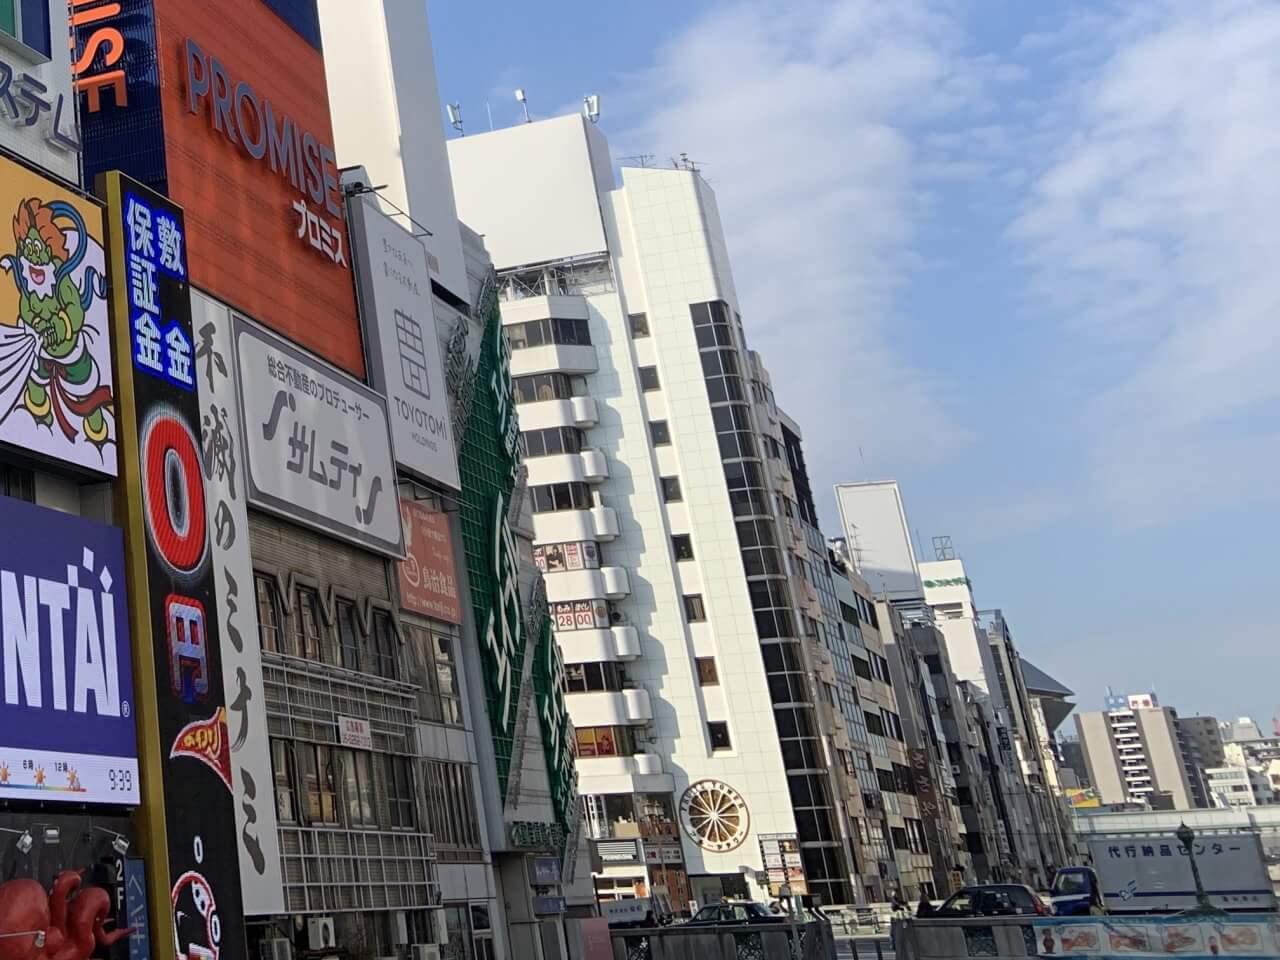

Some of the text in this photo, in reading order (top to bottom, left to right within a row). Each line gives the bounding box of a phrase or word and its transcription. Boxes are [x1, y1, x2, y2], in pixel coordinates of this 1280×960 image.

[184, 36, 342, 220] PROMISE
[292, 199, 349, 270] プロミス
[126, 197, 164, 373] 保証金
[267, 354, 370, 422] 総合不動産のプロデューサー
[287, 421, 363, 498] サムティ
[116, 858, 125, 910] 2F
